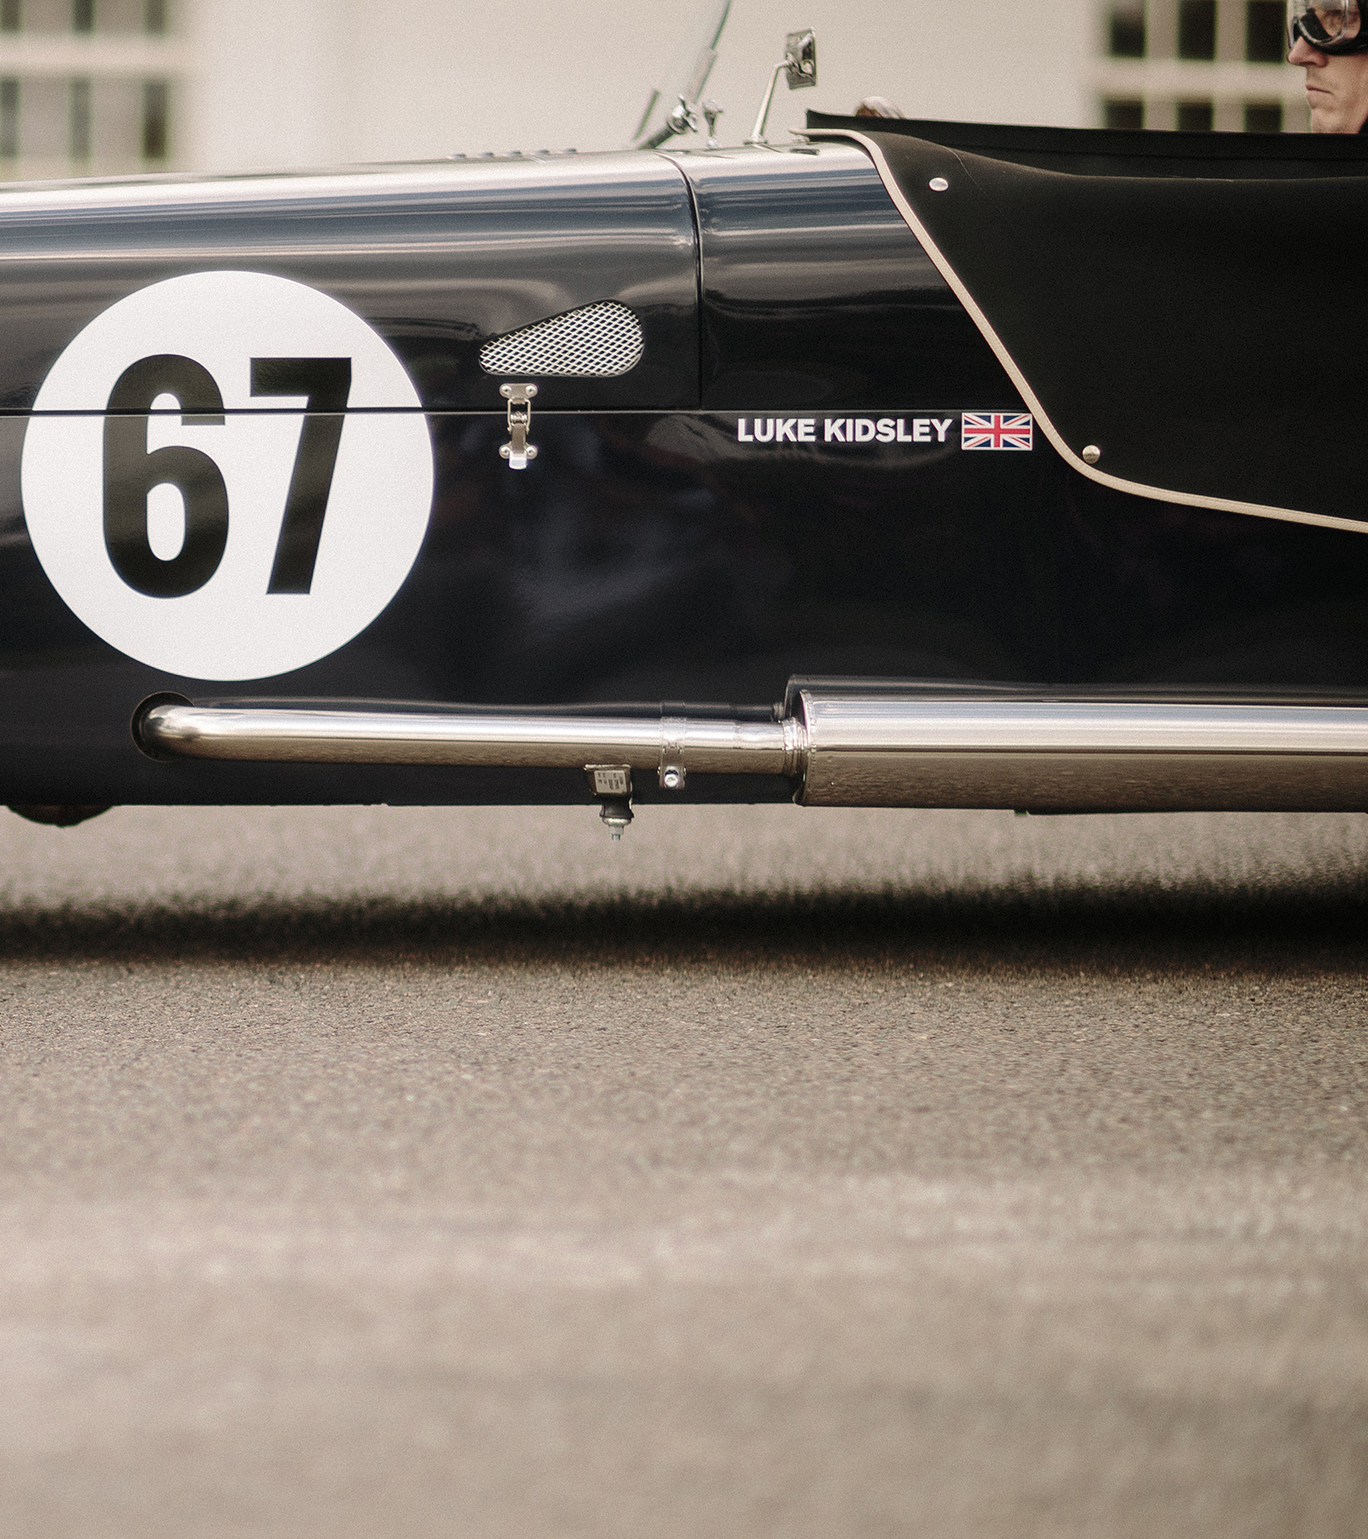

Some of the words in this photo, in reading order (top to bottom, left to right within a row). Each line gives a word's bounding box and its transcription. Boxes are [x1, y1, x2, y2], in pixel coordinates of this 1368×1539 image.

[102, 353, 352, 599] 67
[737, 418, 816, 442] LUKE
[823, 418, 953, 442] KIDSLEY
